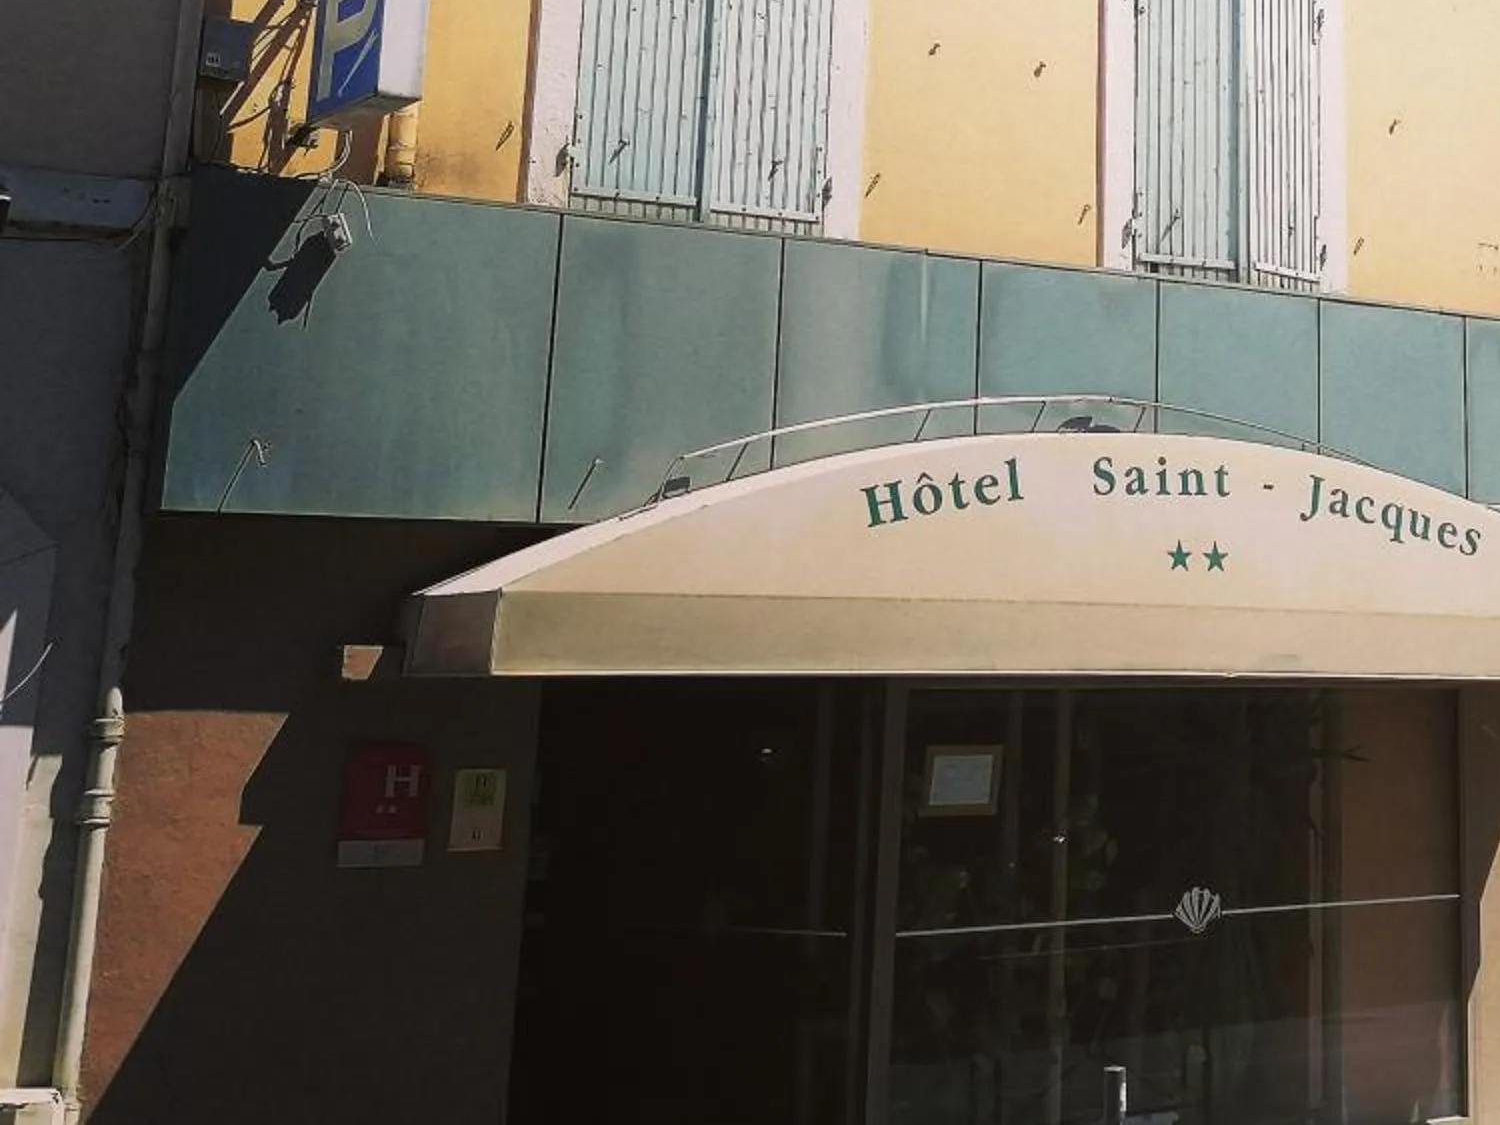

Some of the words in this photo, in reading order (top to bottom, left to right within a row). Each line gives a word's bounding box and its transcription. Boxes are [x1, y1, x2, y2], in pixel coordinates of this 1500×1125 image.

[860, 456, 1025, 528] Hôtel
[1092, 455, 1231, 497] Saint
[1299, 474, 1483, 557] Jacques
[384, 764, 423, 798] H
